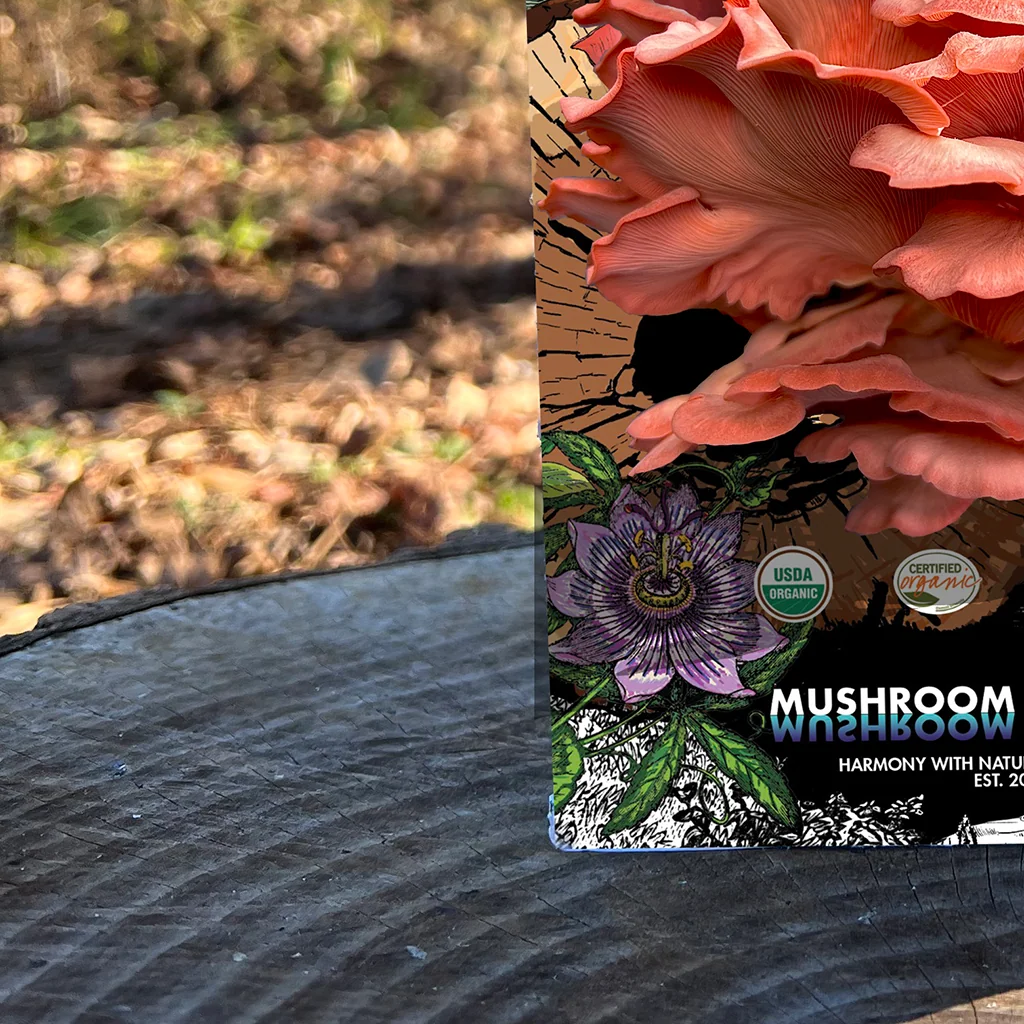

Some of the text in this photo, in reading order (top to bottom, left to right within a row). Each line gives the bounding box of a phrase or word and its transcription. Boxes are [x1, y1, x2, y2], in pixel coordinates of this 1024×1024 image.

[773, 567, 813, 582] USDA
[909, 563, 962, 574] CERTIFIED
[900, 567, 983, 597] organic
[769, 587, 818, 600] ORGANIC
[770, 685, 1015, 715] MUSHROOM
[839, 757, 927, 772] HARMONY
[931, 756, 974, 771] WITH
[974, 773, 1003, 787] EST.
